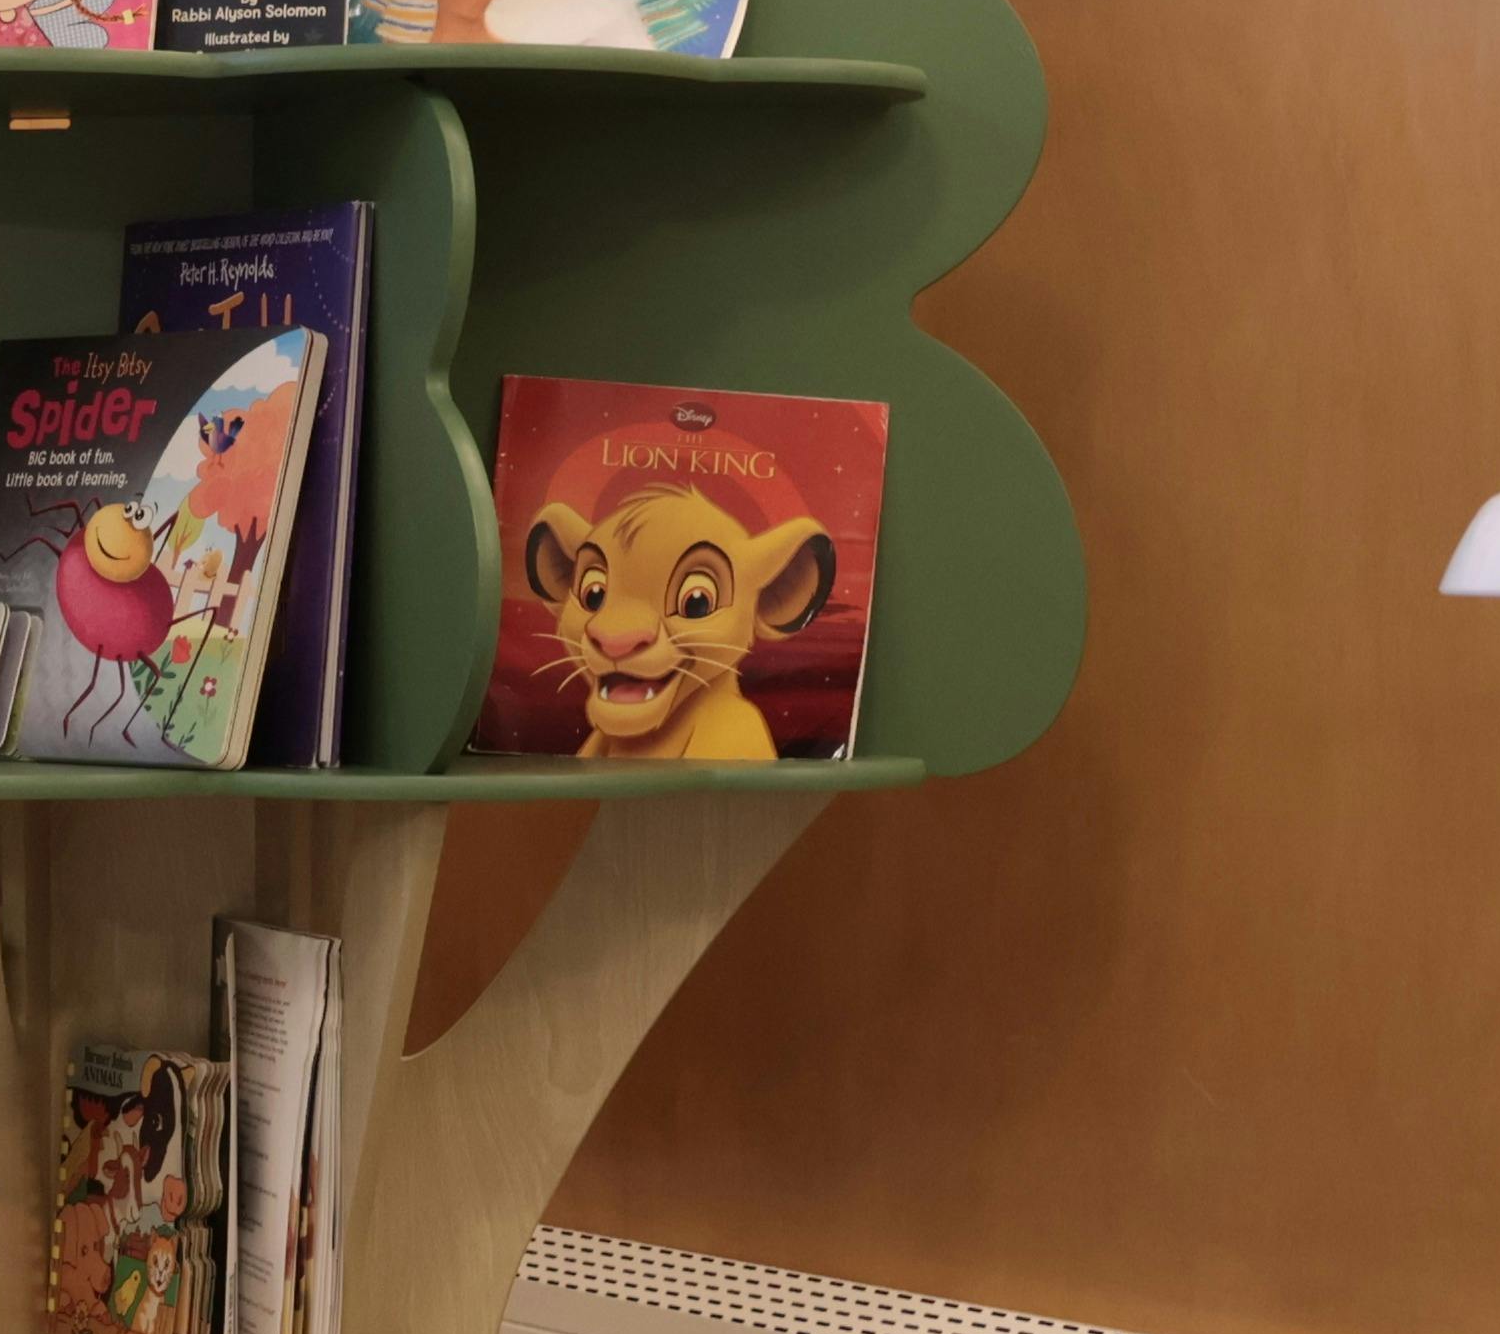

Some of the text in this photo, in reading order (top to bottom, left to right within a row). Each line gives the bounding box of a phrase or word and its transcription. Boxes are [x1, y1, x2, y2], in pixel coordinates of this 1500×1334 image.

[171, 3, 327, 23] Rabbi Alyson Solomon
[204, 29, 290, 46] Illustrated by
[180, 254, 275, 291] Peter H. Reynolds
[53, 351, 152, 385] The Itsy Bitsy
[7, 380, 157, 449] Spider
[673, 406, 713, 427] Disney
[28, 448, 115, 465] BIG book of fun.
[602, 438, 776, 479] LION KING
[5, 471, 129, 489] Little book of learning.
